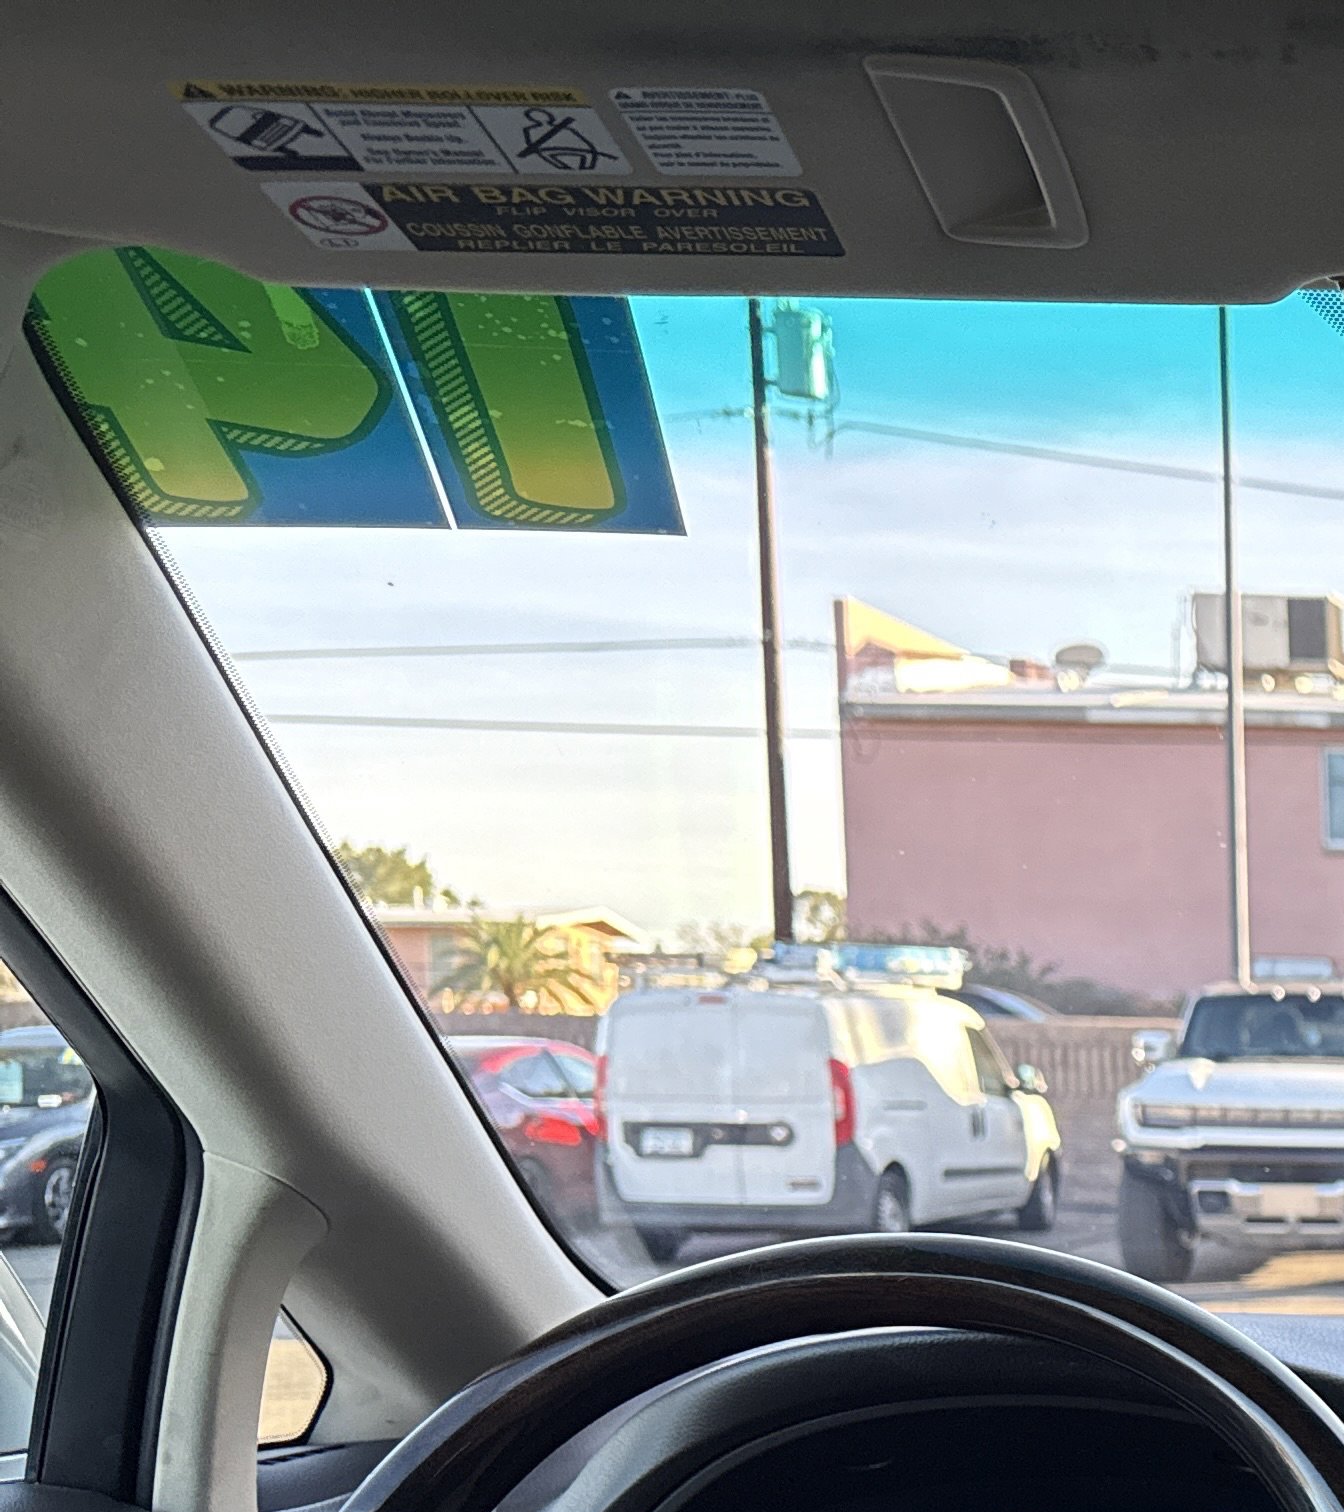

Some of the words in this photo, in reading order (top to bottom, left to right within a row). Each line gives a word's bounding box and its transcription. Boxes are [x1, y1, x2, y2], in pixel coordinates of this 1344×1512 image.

[382, 184, 460, 203] AIR
[471, 185, 576, 205] BAG
[581, 187, 811, 208] WARNING
[497, 206, 546, 216] FLIP
[563, 207, 636, 218] VISOR
[654, 208, 719, 218] OVER
[406, 222, 507, 239] COUSSIN
[511, 223, 649, 240] GONFLABLE
[656, 225, 828, 241] AVERTISSEMENT
[458, 240, 570, 250] REPLIER
[591, 241, 623, 251] LE
[643, 242, 806, 254] PARESOLEIL
